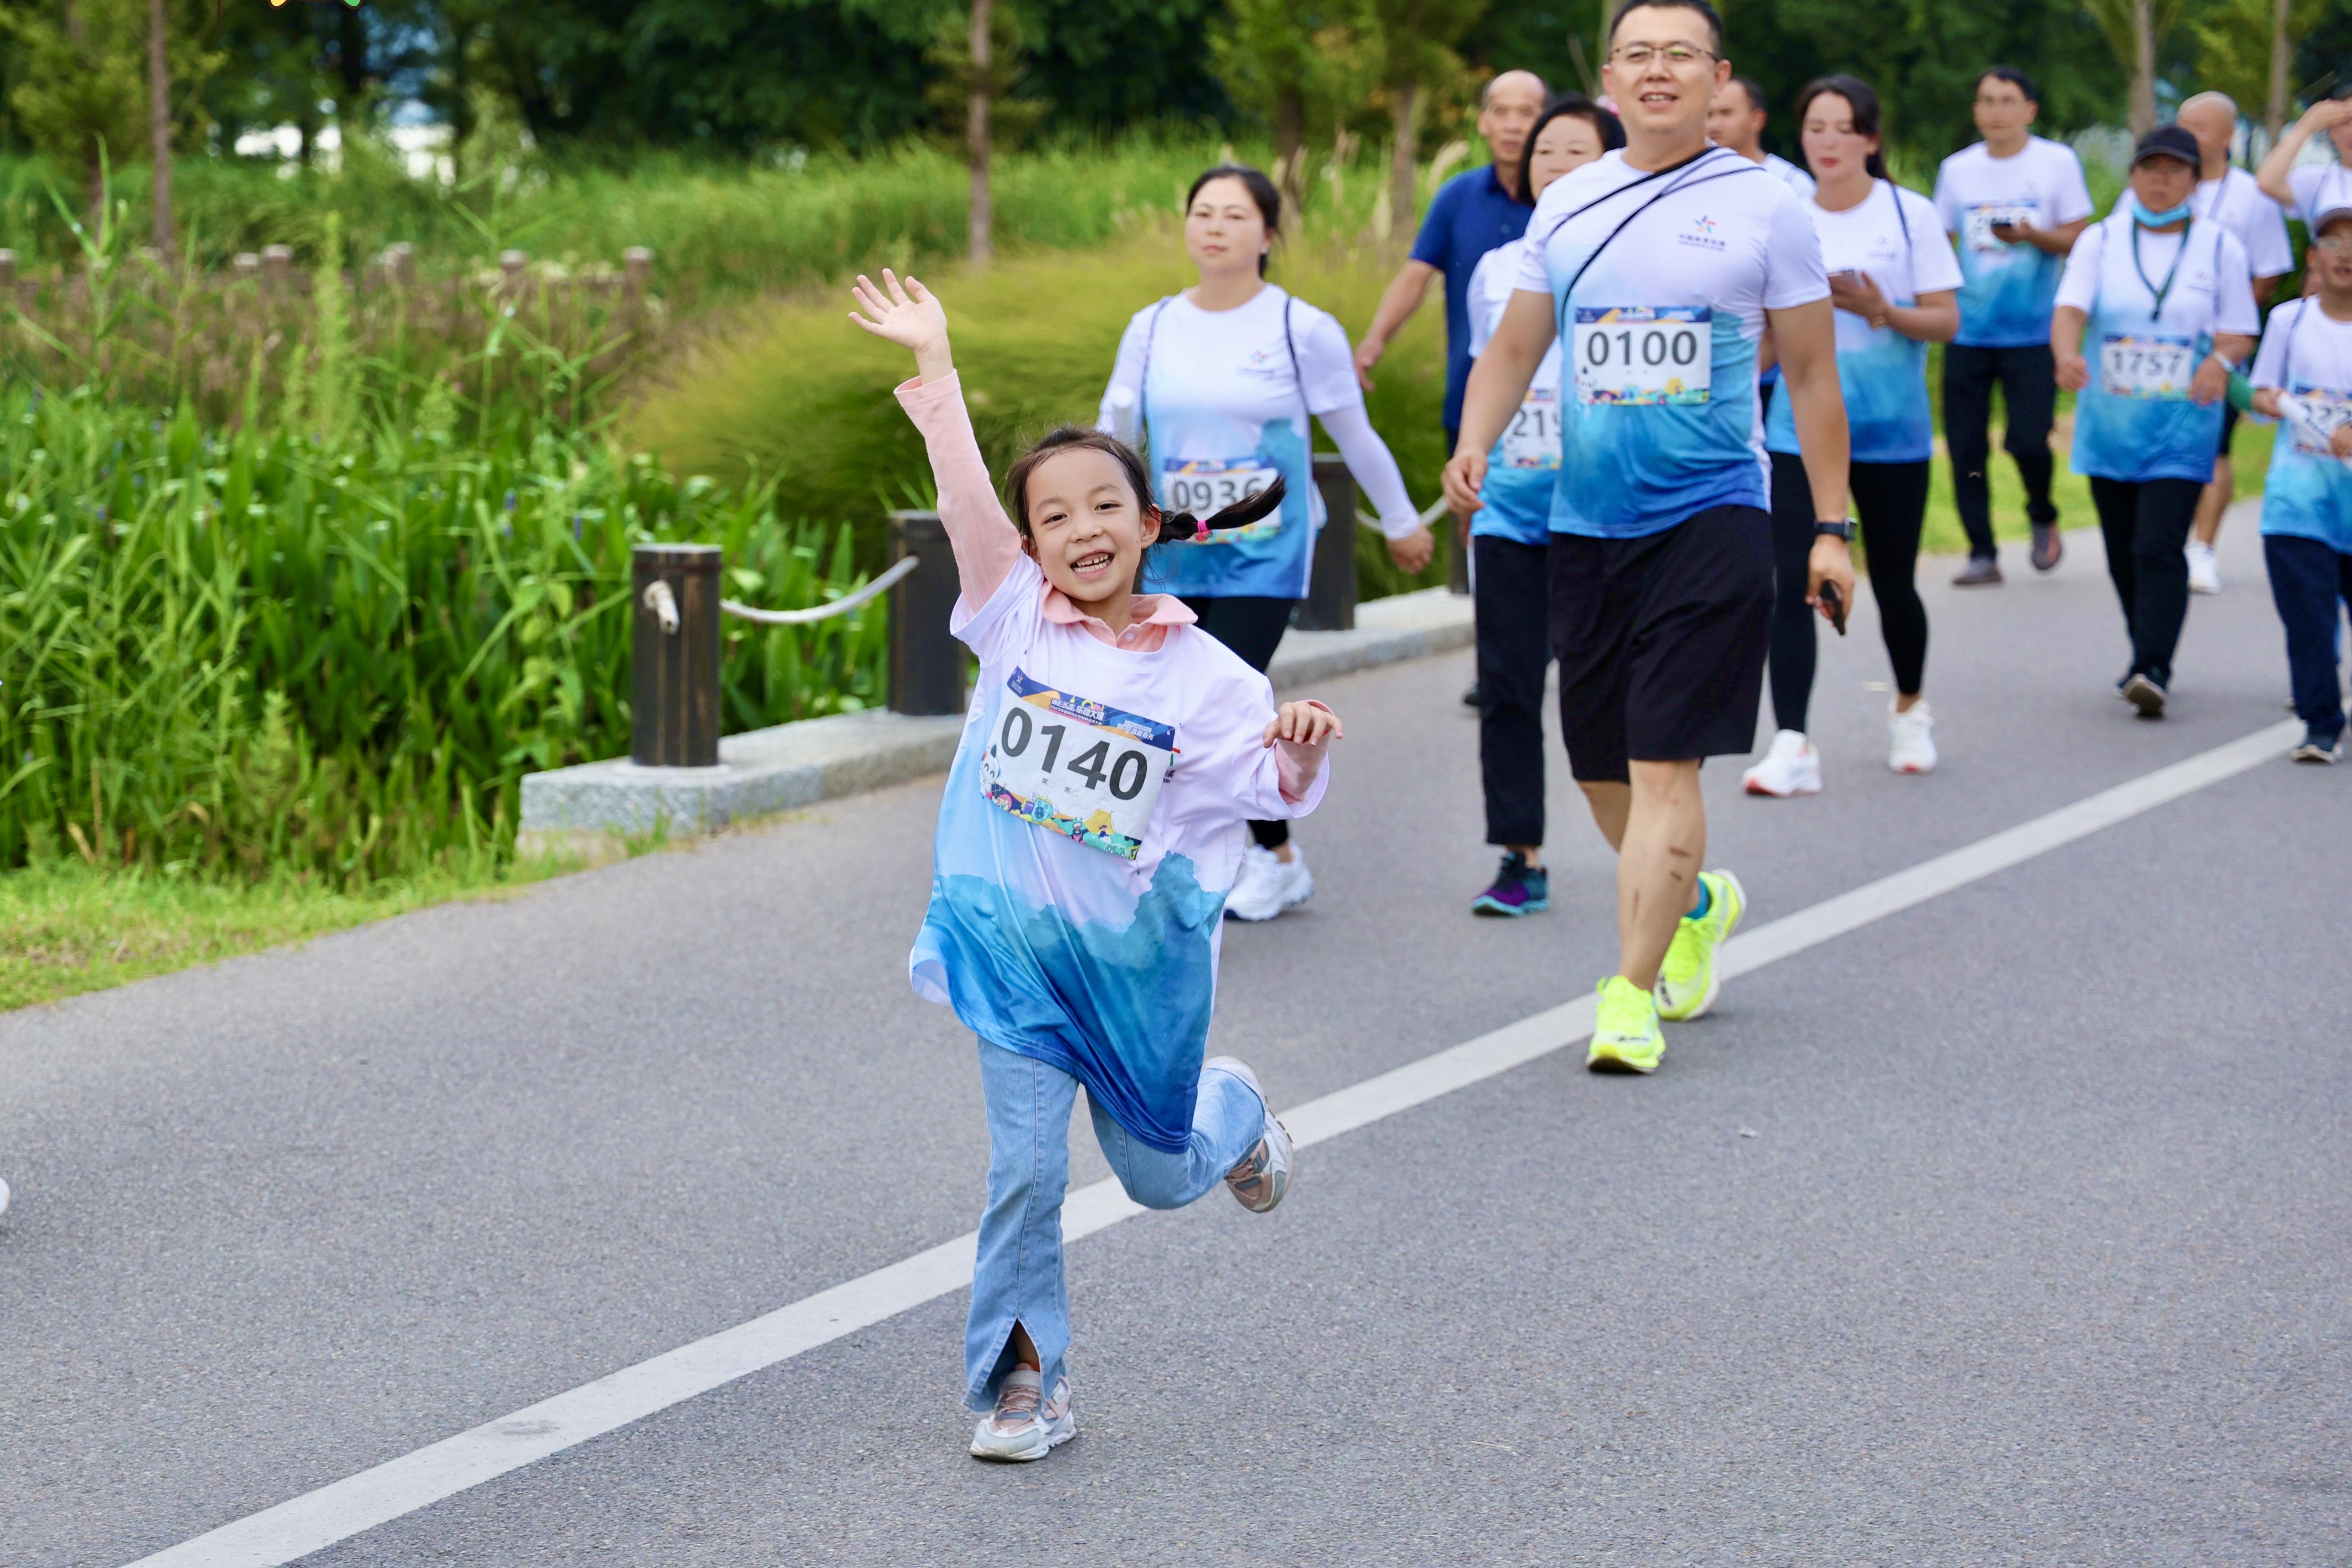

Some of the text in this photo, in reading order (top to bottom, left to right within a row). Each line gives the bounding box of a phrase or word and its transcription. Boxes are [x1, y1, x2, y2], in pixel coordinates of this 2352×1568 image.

[1588, 331, 1697, 366] 0100
[2112, 350, 2182, 376] 1757
[1001, 706, 1147, 800] 0140
